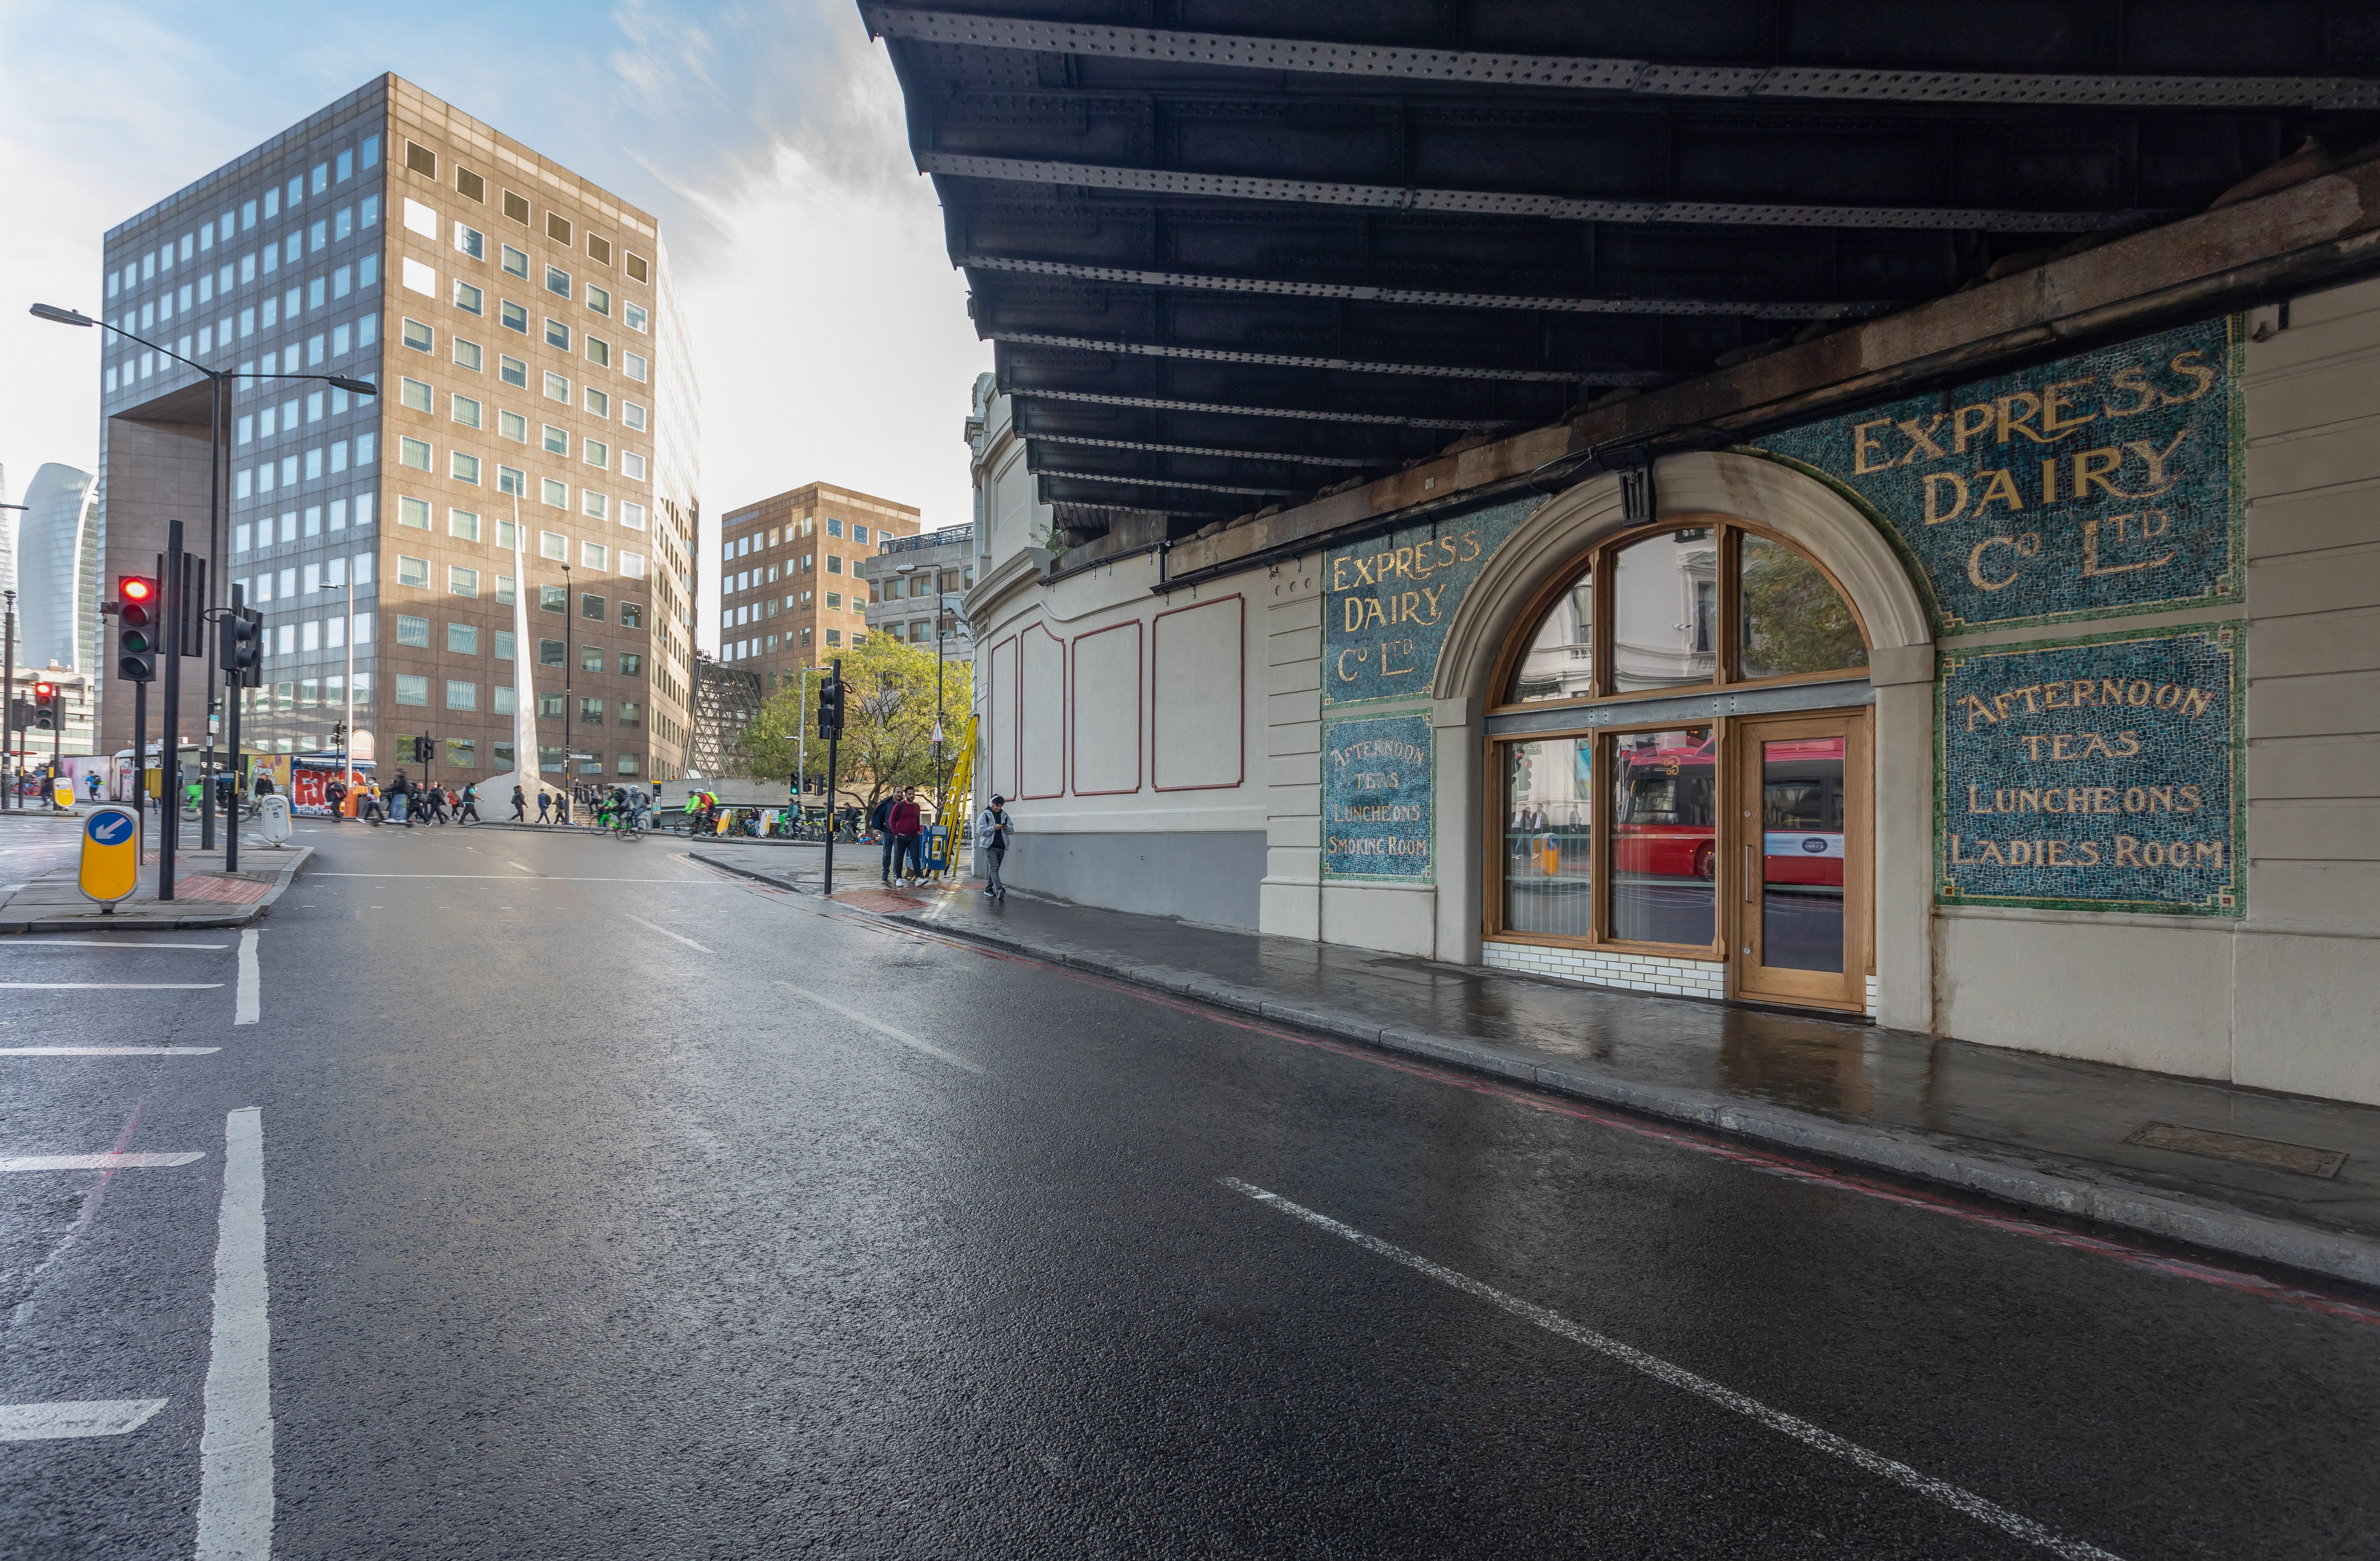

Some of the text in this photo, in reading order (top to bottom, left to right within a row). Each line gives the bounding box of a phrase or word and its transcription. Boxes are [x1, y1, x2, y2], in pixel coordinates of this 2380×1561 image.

[1853, 348, 2216, 476] EXPRESS
[1922, 429, 2187, 525] DAIRY
[1333, 530, 1481, 591] EXPRESS
[1345, 584, 1447, 633] DAIRY
[1955, 678, 2214, 733] AFTERNOON
[1330, 740, 1425, 772] AFTERNOON
[2021, 729, 2140, 761] TEAS
[1354, 772, 1398, 789] TEAS
[1333, 803, 1420, 822] LUNCHEONS
[1967, 784, 2203, 813] LUNCHEONS
[1327, 836, 1427, 856] SMOKING ROOM
[1950, 833, 2225, 869] LADIES ROOM
